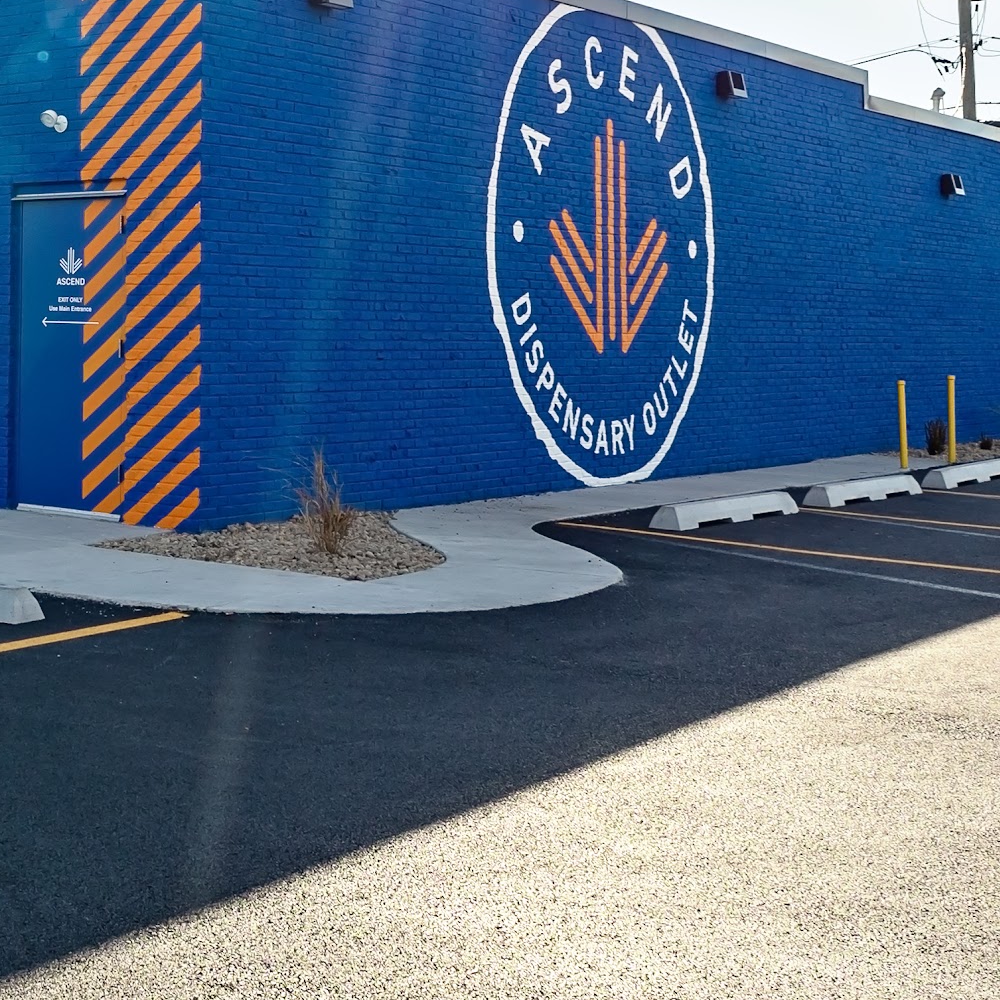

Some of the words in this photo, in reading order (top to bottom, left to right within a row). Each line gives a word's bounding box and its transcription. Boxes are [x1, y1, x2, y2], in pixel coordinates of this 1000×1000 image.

[520, 36, 693, 199] ASCEND
[56, 277, 85, 286] ASCEND
[511, 292, 635, 455] DISPENSARY
[642, 299, 697, 435] OUTLET
